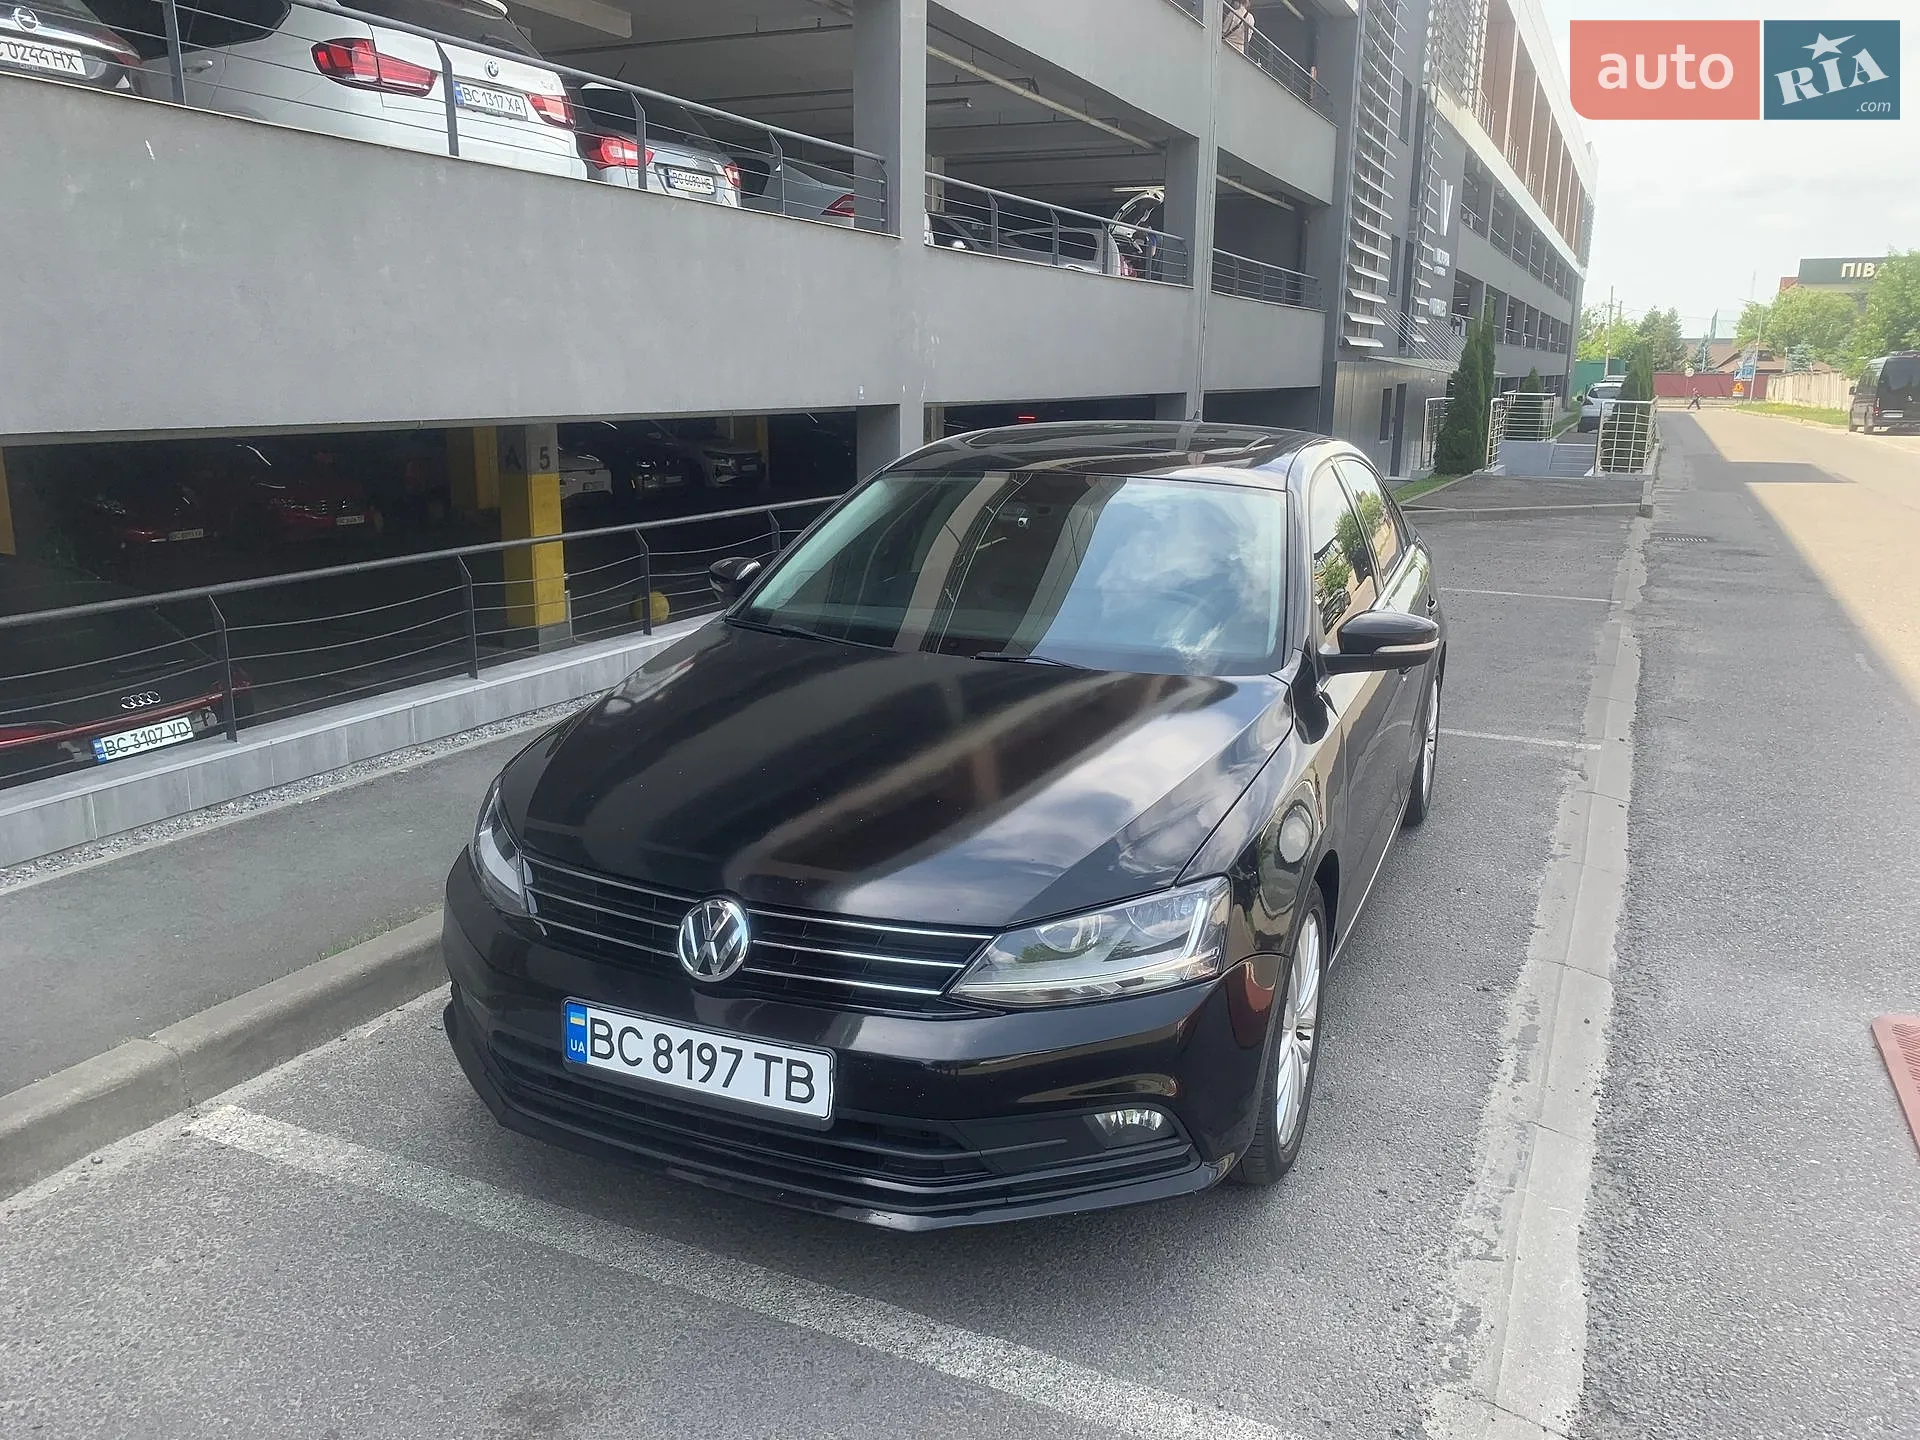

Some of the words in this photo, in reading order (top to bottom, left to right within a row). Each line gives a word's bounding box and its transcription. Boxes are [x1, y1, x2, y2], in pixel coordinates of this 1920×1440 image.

[462, 87, 480, 103] BC
[481, 91, 504, 109] 1317
[505, 95, 523, 113] XA
[539, 446, 550, 470] 5
[104, 738, 128, 757] BC
[130, 726, 164, 749] 3107
[570, 1038, 586, 1055] UA
[590, 1017, 644, 1067] BC
[652, 1033, 743, 1089] 8197
[753, 1052, 816, 1104] TB
